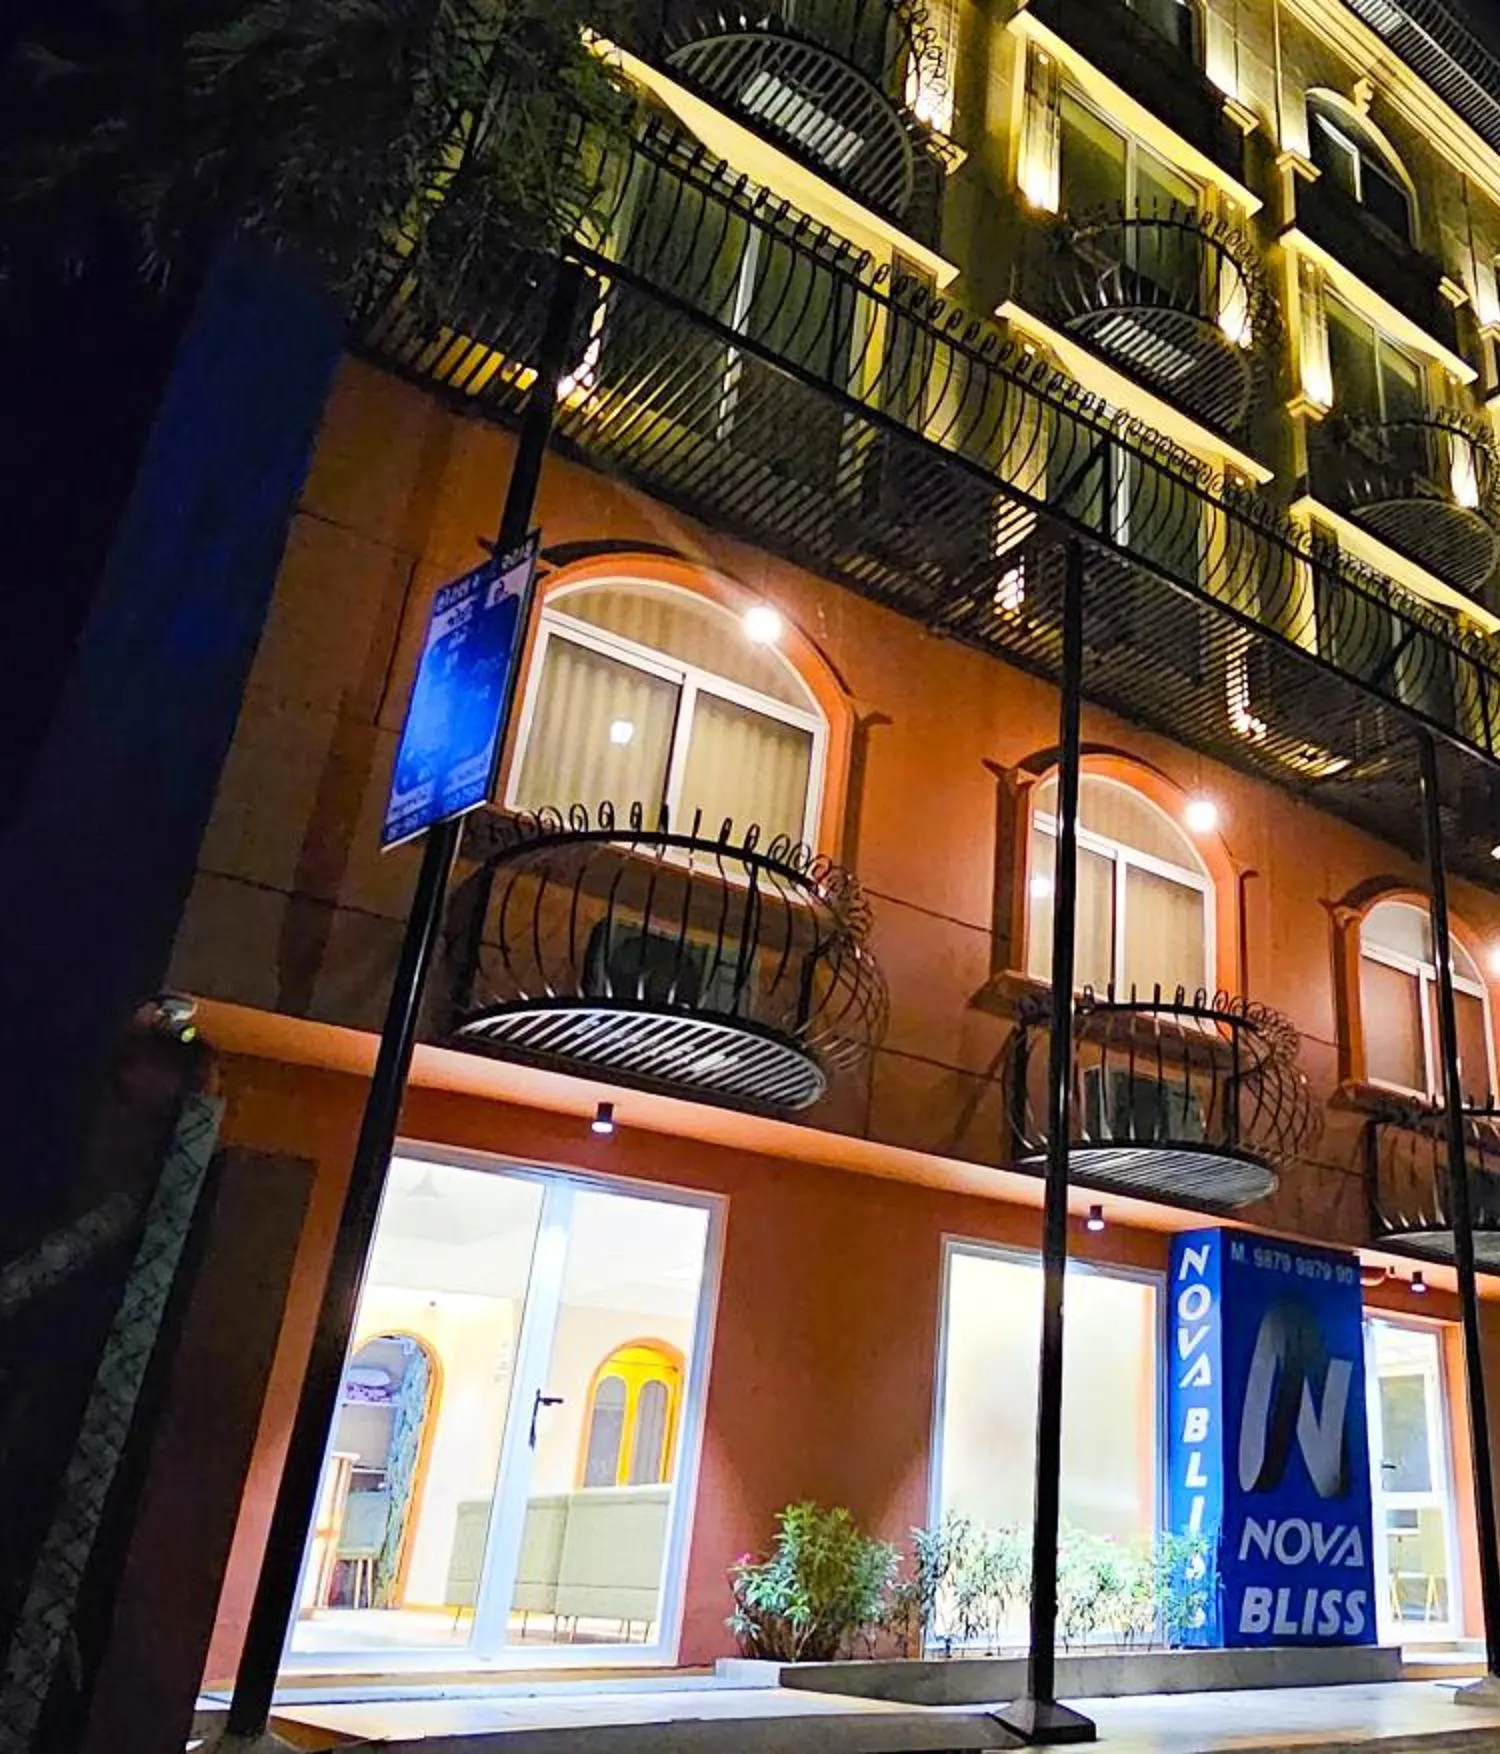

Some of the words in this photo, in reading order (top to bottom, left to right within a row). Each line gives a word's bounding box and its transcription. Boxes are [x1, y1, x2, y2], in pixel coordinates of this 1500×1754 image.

[1178, 1244, 1212, 1388] NOVA
[1238, 1517, 1365, 1567] NOVA
[1239, 1585, 1367, 1636] BLISS
